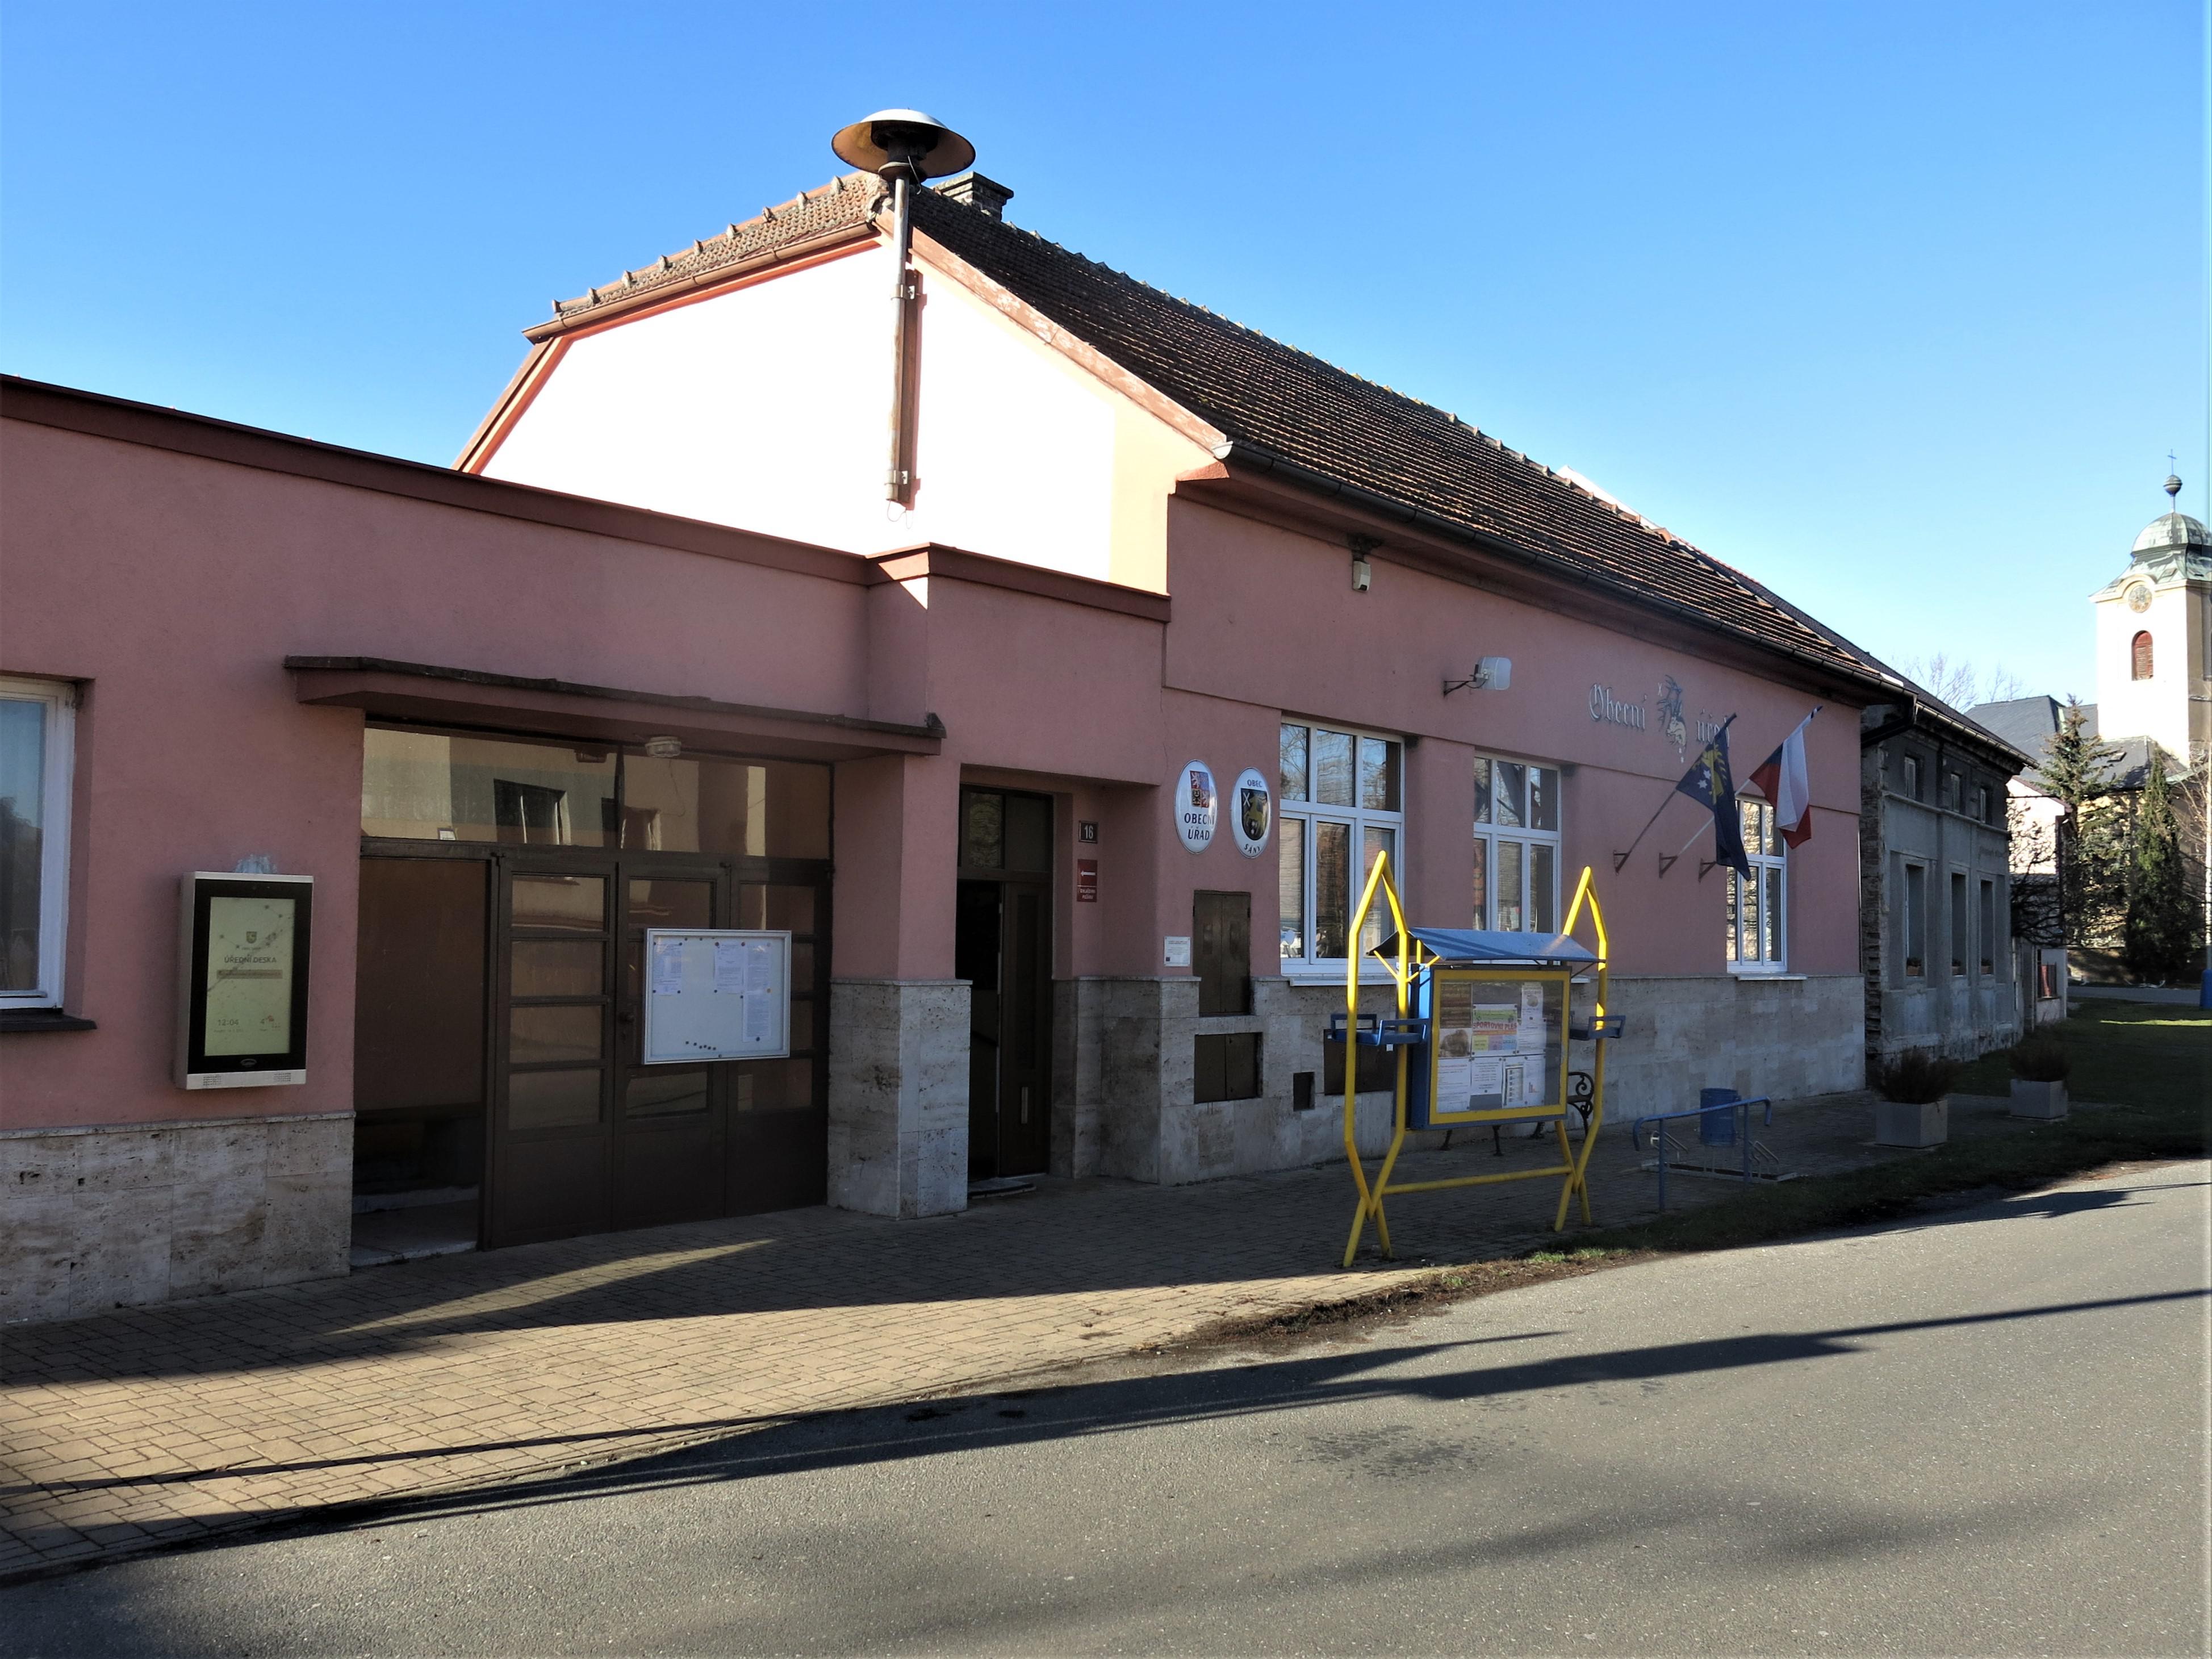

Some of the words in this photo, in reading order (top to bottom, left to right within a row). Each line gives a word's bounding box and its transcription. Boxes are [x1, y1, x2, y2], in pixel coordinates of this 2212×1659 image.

[1247, 779, 1263, 788] OBEC
[1084, 825, 1094, 839] 16
[1187, 826, 1210, 841] ÚŘAD
[224, 955, 252, 963] ÚŘEDNÍ
